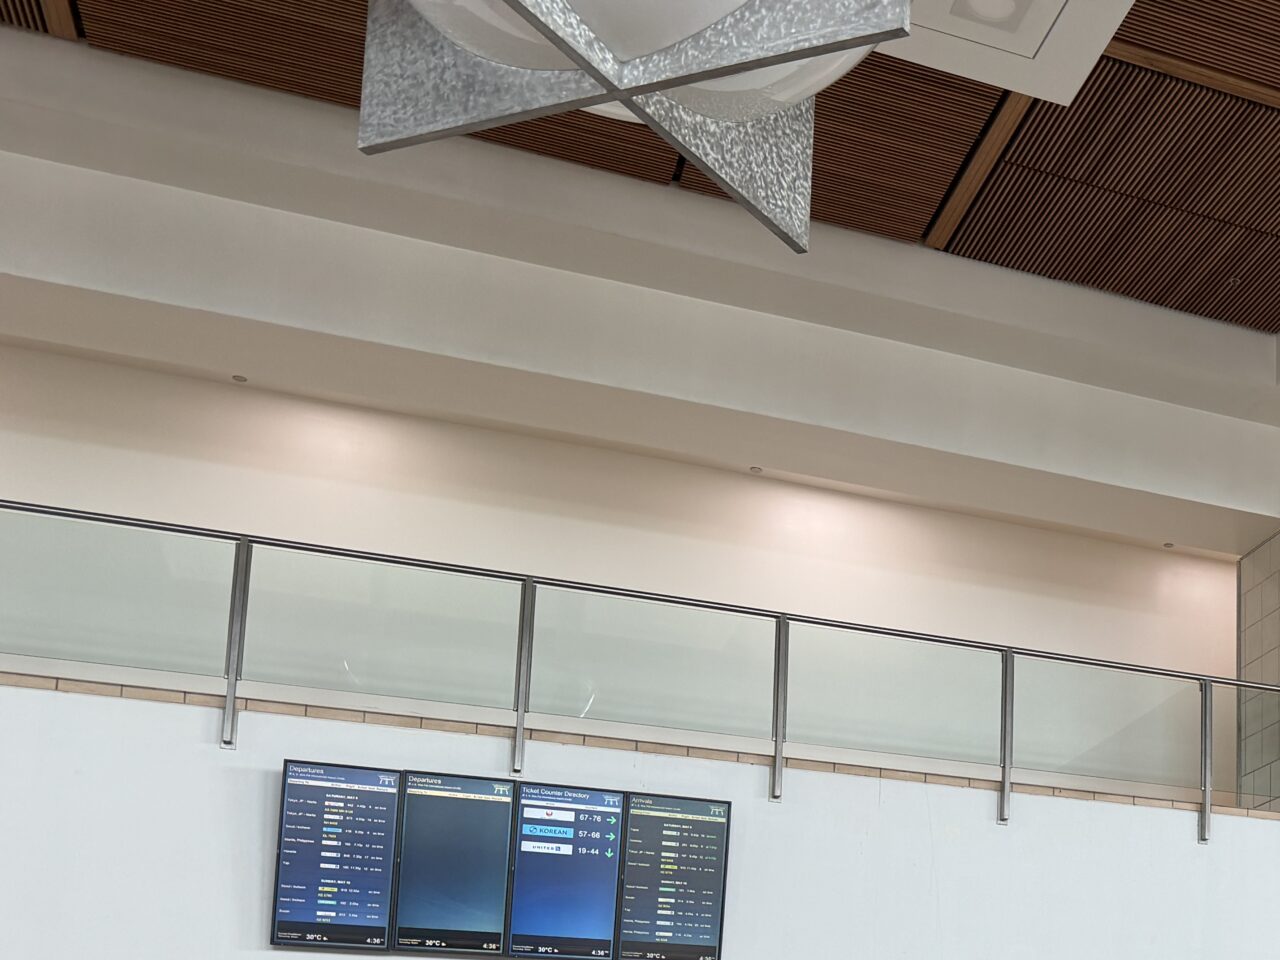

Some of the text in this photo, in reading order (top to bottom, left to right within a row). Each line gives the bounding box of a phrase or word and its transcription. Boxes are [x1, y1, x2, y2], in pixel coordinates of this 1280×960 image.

[289, 765, 324, 774] Departures
[408, 776, 442, 784] Departures
[540, 788, 562, 796] Counter
[564, 790, 590, 800] Directory
[540, 827, 568, 836] KOREAN
